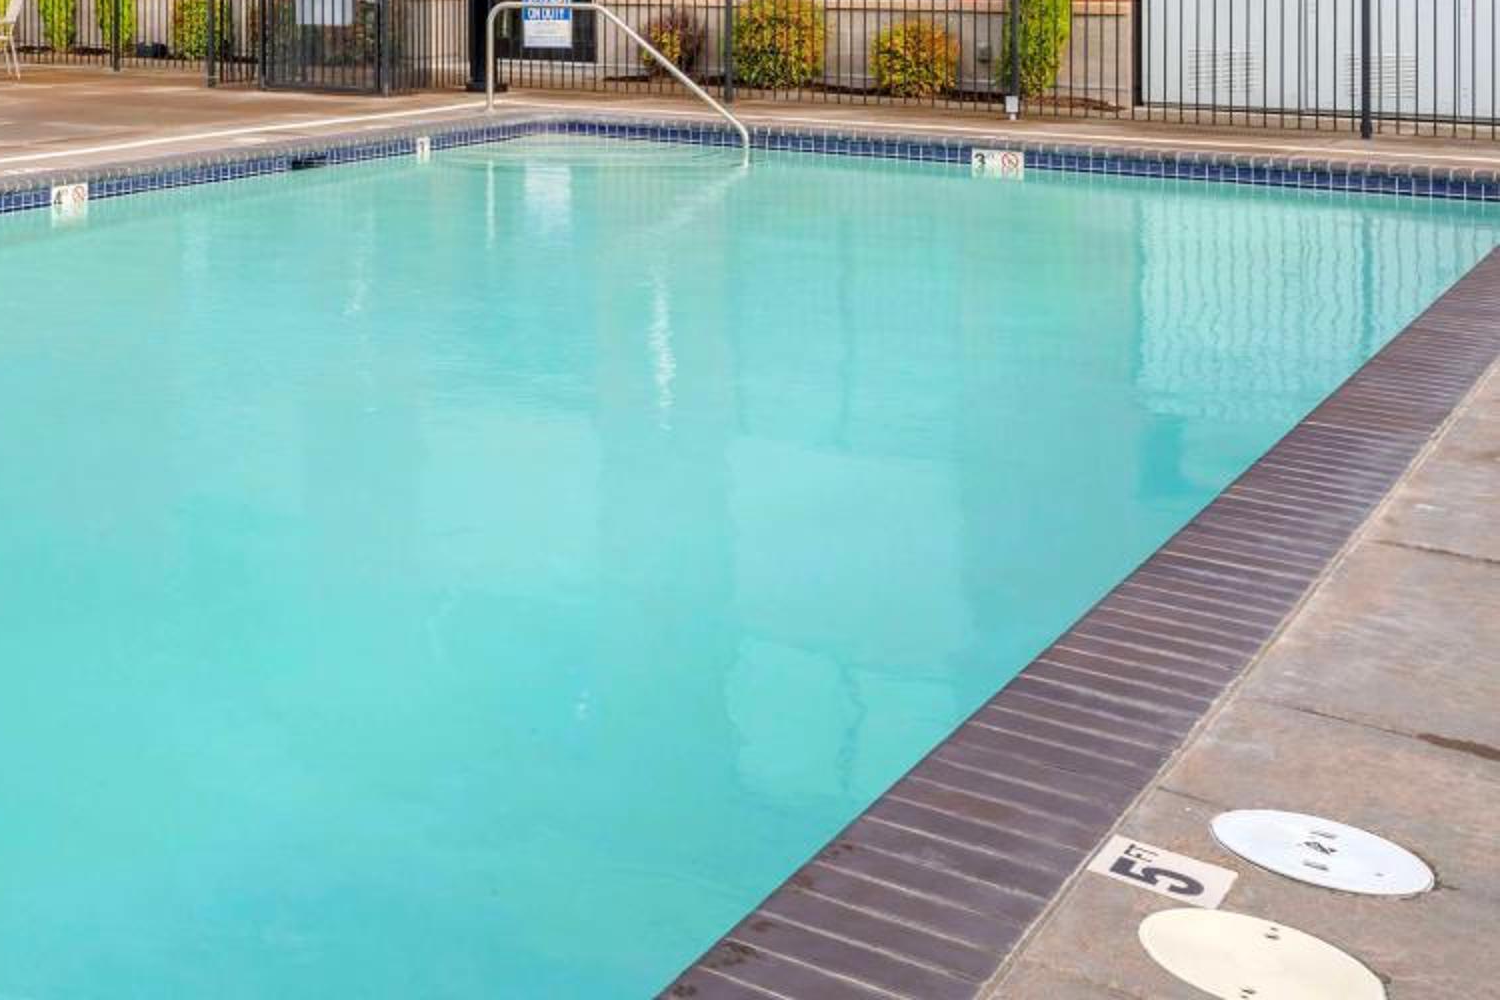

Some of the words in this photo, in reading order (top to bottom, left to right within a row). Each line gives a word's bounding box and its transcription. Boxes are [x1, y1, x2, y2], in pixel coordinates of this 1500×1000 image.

[528, 7, 541, 20] ON
[542, 7, 564, 20] DUTY
[53, 189, 63, 204] 4
[1123, 843, 1158, 863] FT
[1109, 856, 1204, 896] 5
